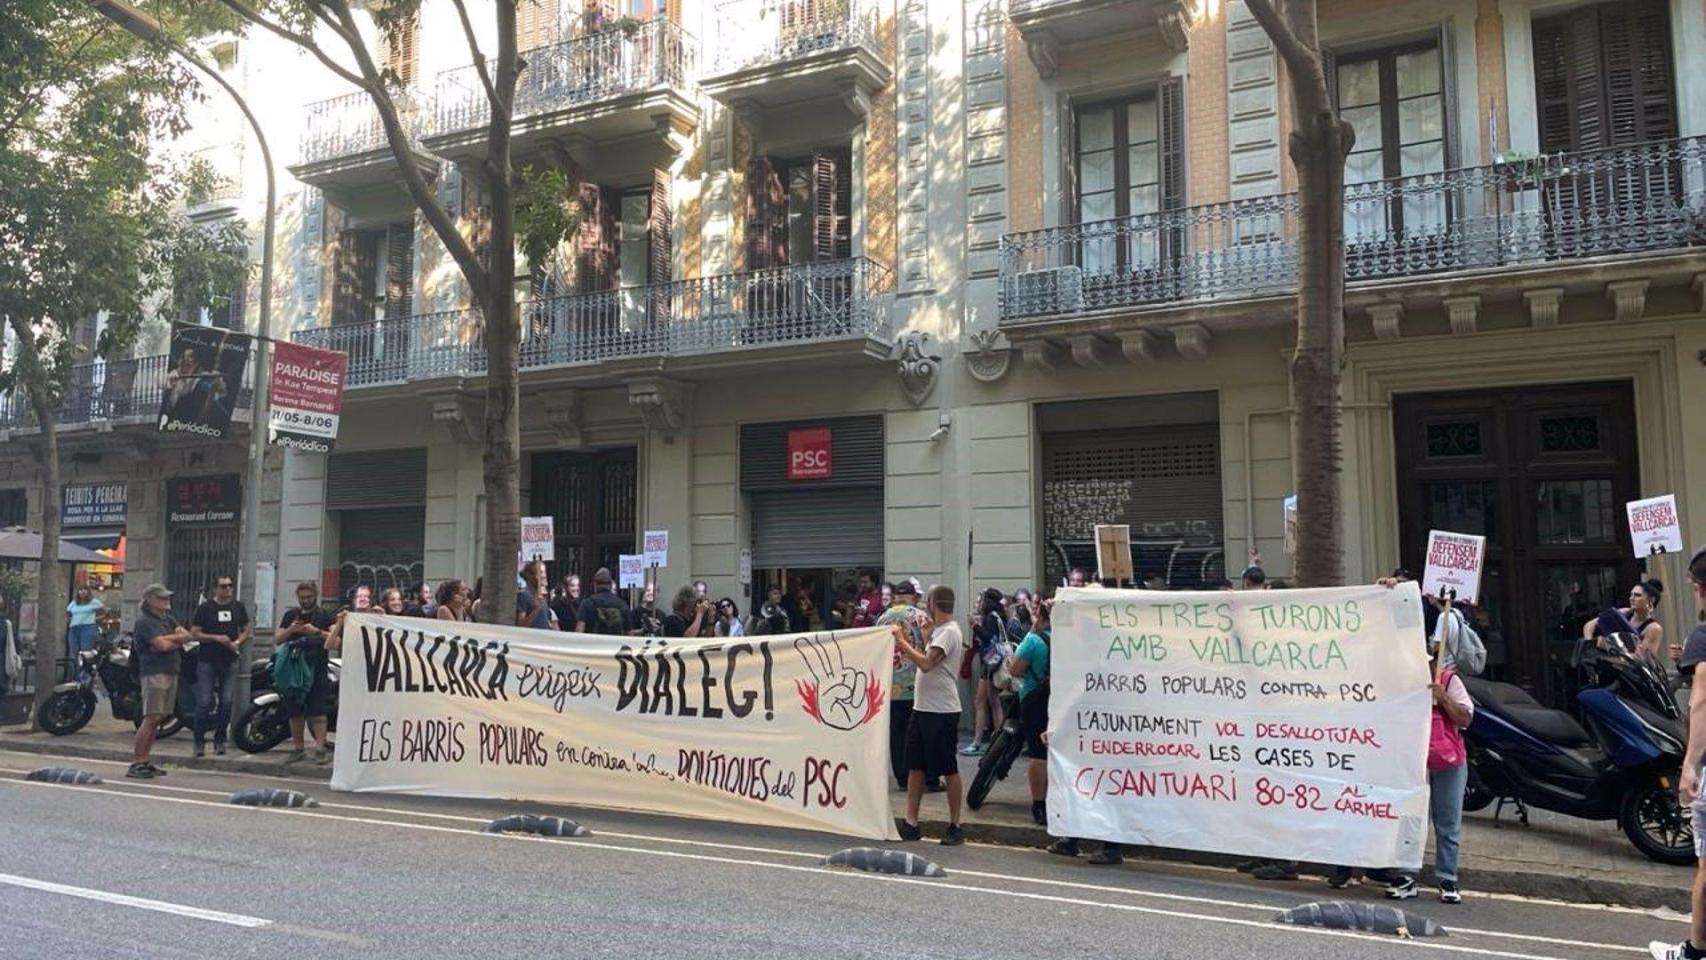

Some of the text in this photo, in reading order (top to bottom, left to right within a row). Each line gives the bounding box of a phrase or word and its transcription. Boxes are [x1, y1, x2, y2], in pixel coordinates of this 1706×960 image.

[275, 362, 340, 385] PARADISE
[792, 450, 827, 468] PSC
[1429, 552, 1478, 572] VALLCARCA!
[1432, 541, 1477, 557] DEFENSEM
[1098, 600, 1361, 632] ELS TRES TURONS
[1107, 634, 1348, 671] AMB VALLCARCA
[361, 626, 509, 701] VALLCARCA
[516, 664, 601, 713] exigeix
[1085, 672, 1376, 702] BARRIS POPULARS CONTRA PSC
[1216, 721, 1244, 737] VOL
[1256, 722, 1381, 748] DESALLOTJAR
[359, 719, 391, 762] ELS
[480, 721, 548, 767] POPULARS
[556, 741, 579, 763] en
[771, 770, 795, 799] del
[803, 756, 848, 808] PSC
[1092, 740, 1200, 759] ENDERROCAR
[1209, 744, 1241, 762] LES
[1255, 747, 1314, 767] CASES
[1326, 752, 1356, 771] DE
[1256, 777, 1329, 811] 80-82
[1341, 785, 1367, 798] AL
[1334, 798, 1399, 819] CARMEL
